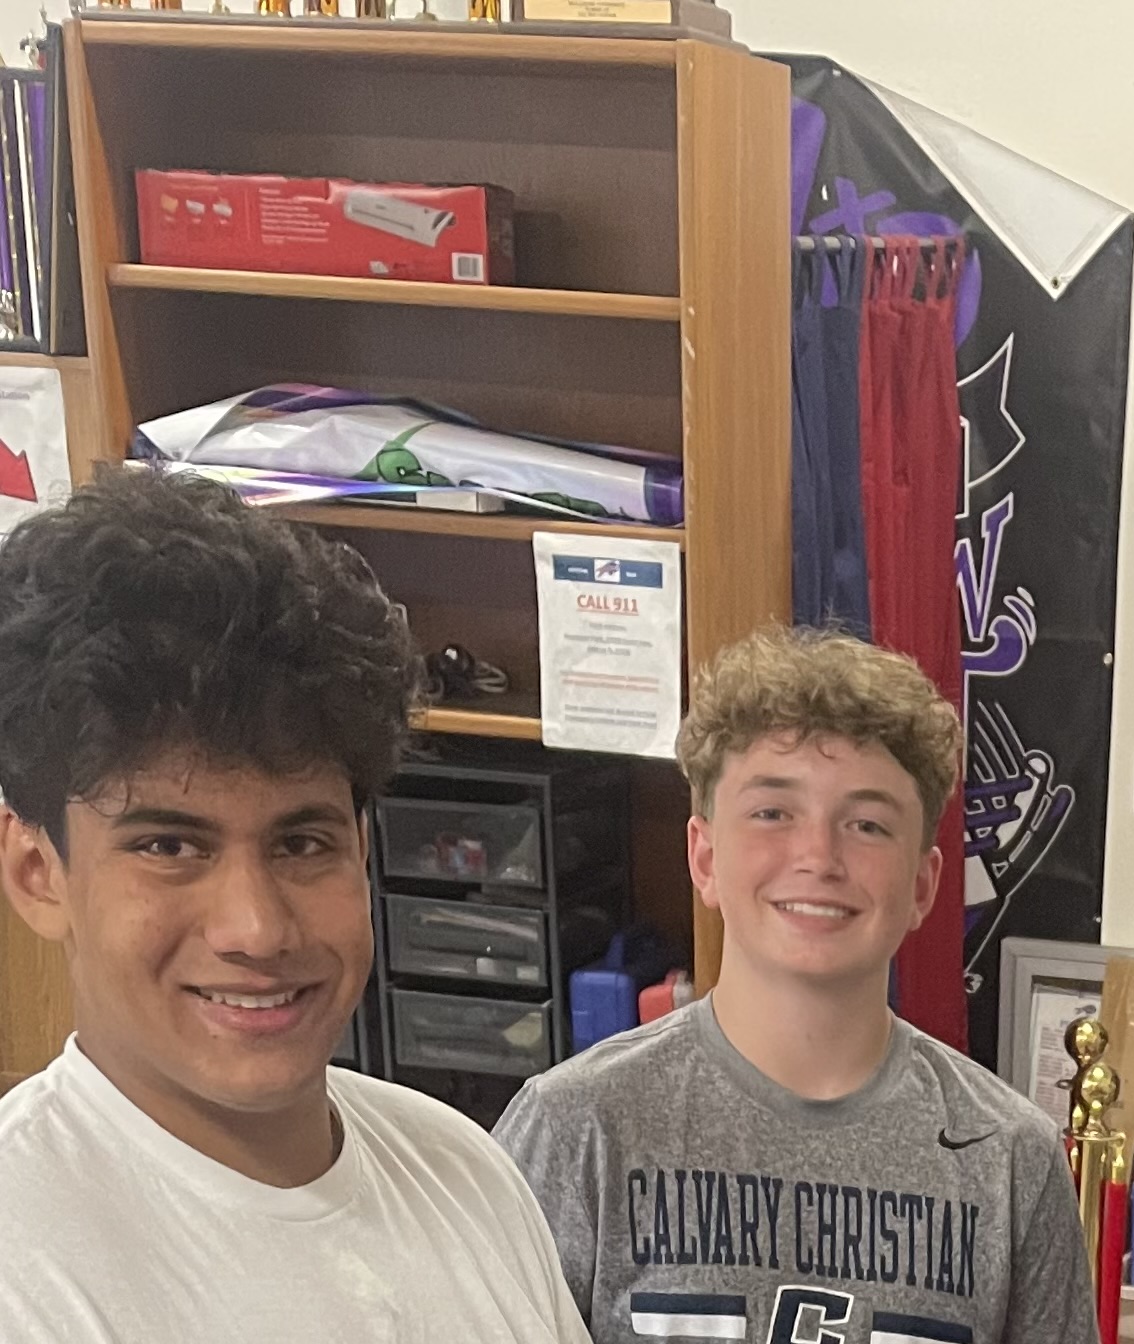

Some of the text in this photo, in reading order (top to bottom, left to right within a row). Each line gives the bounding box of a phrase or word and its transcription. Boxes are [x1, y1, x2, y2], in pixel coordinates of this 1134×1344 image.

[576, 594, 639, 613] CALL 911
[627, 1167, 980, 1299] CALVARY CHRISTIAN
